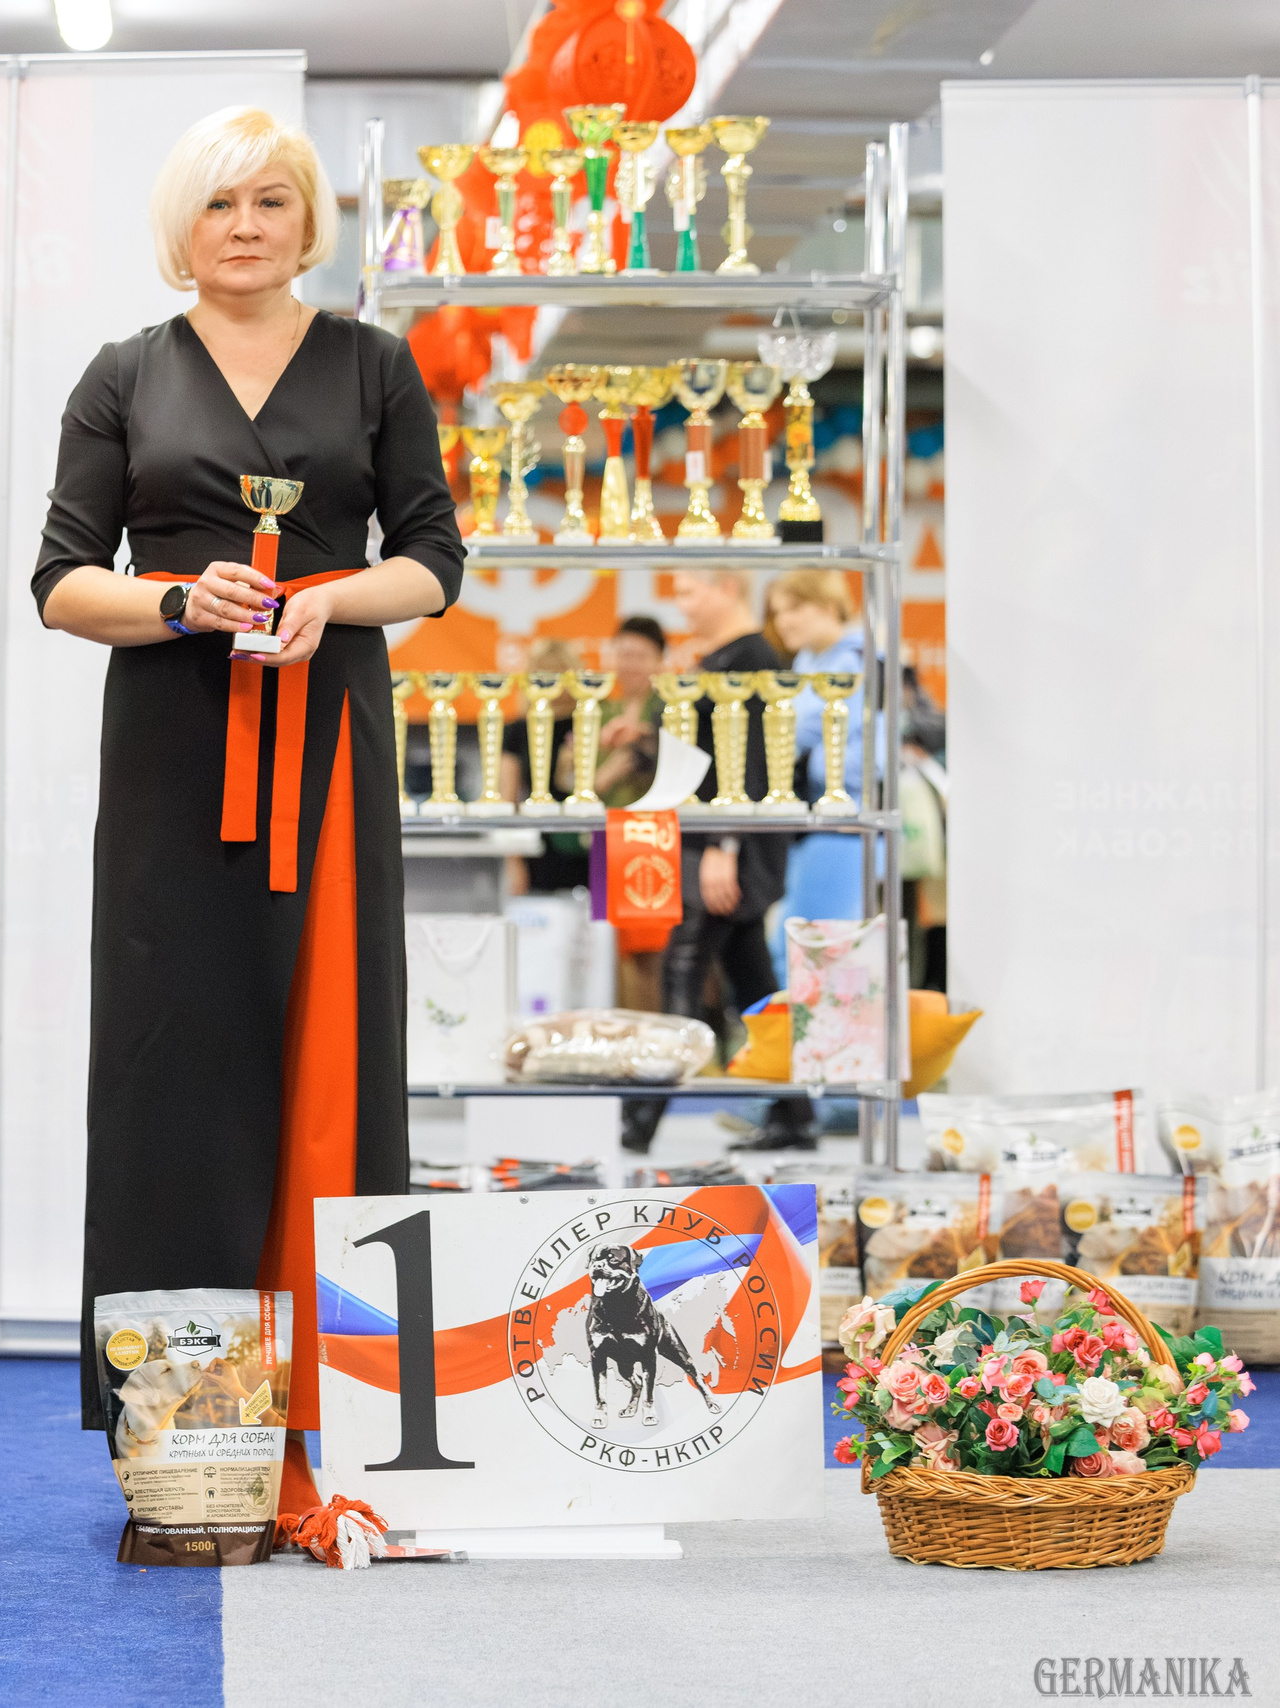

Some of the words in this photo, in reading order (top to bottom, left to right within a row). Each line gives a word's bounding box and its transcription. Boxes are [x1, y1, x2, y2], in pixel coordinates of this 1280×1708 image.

[513, 1211, 611, 1402] РОТВЕЙЛЕР
[633, 1205, 725, 1246] КЛУБ
[732, 1251, 777, 1397] РОССИИ
[264, 1321, 272, 1336] ДЛЯ
[179, 1338, 209, 1346] БЭКС
[352, 1210, 475, 1472] 1
[171, 1434, 206, 1445] КОРМ
[208, 1433, 237, 1448] ДЛЯ
[241, 1432, 275, 1444] СОБАК
[579, 1425, 724, 1467] РКФ-НКПР
[169, 1449, 206, 1459] КРУПНЫХ
[208, 1449, 214, 1457] И
[216, 1448, 251, 1459] СРЕДНИХ
[184, 1541, 216, 1552] 1500г
